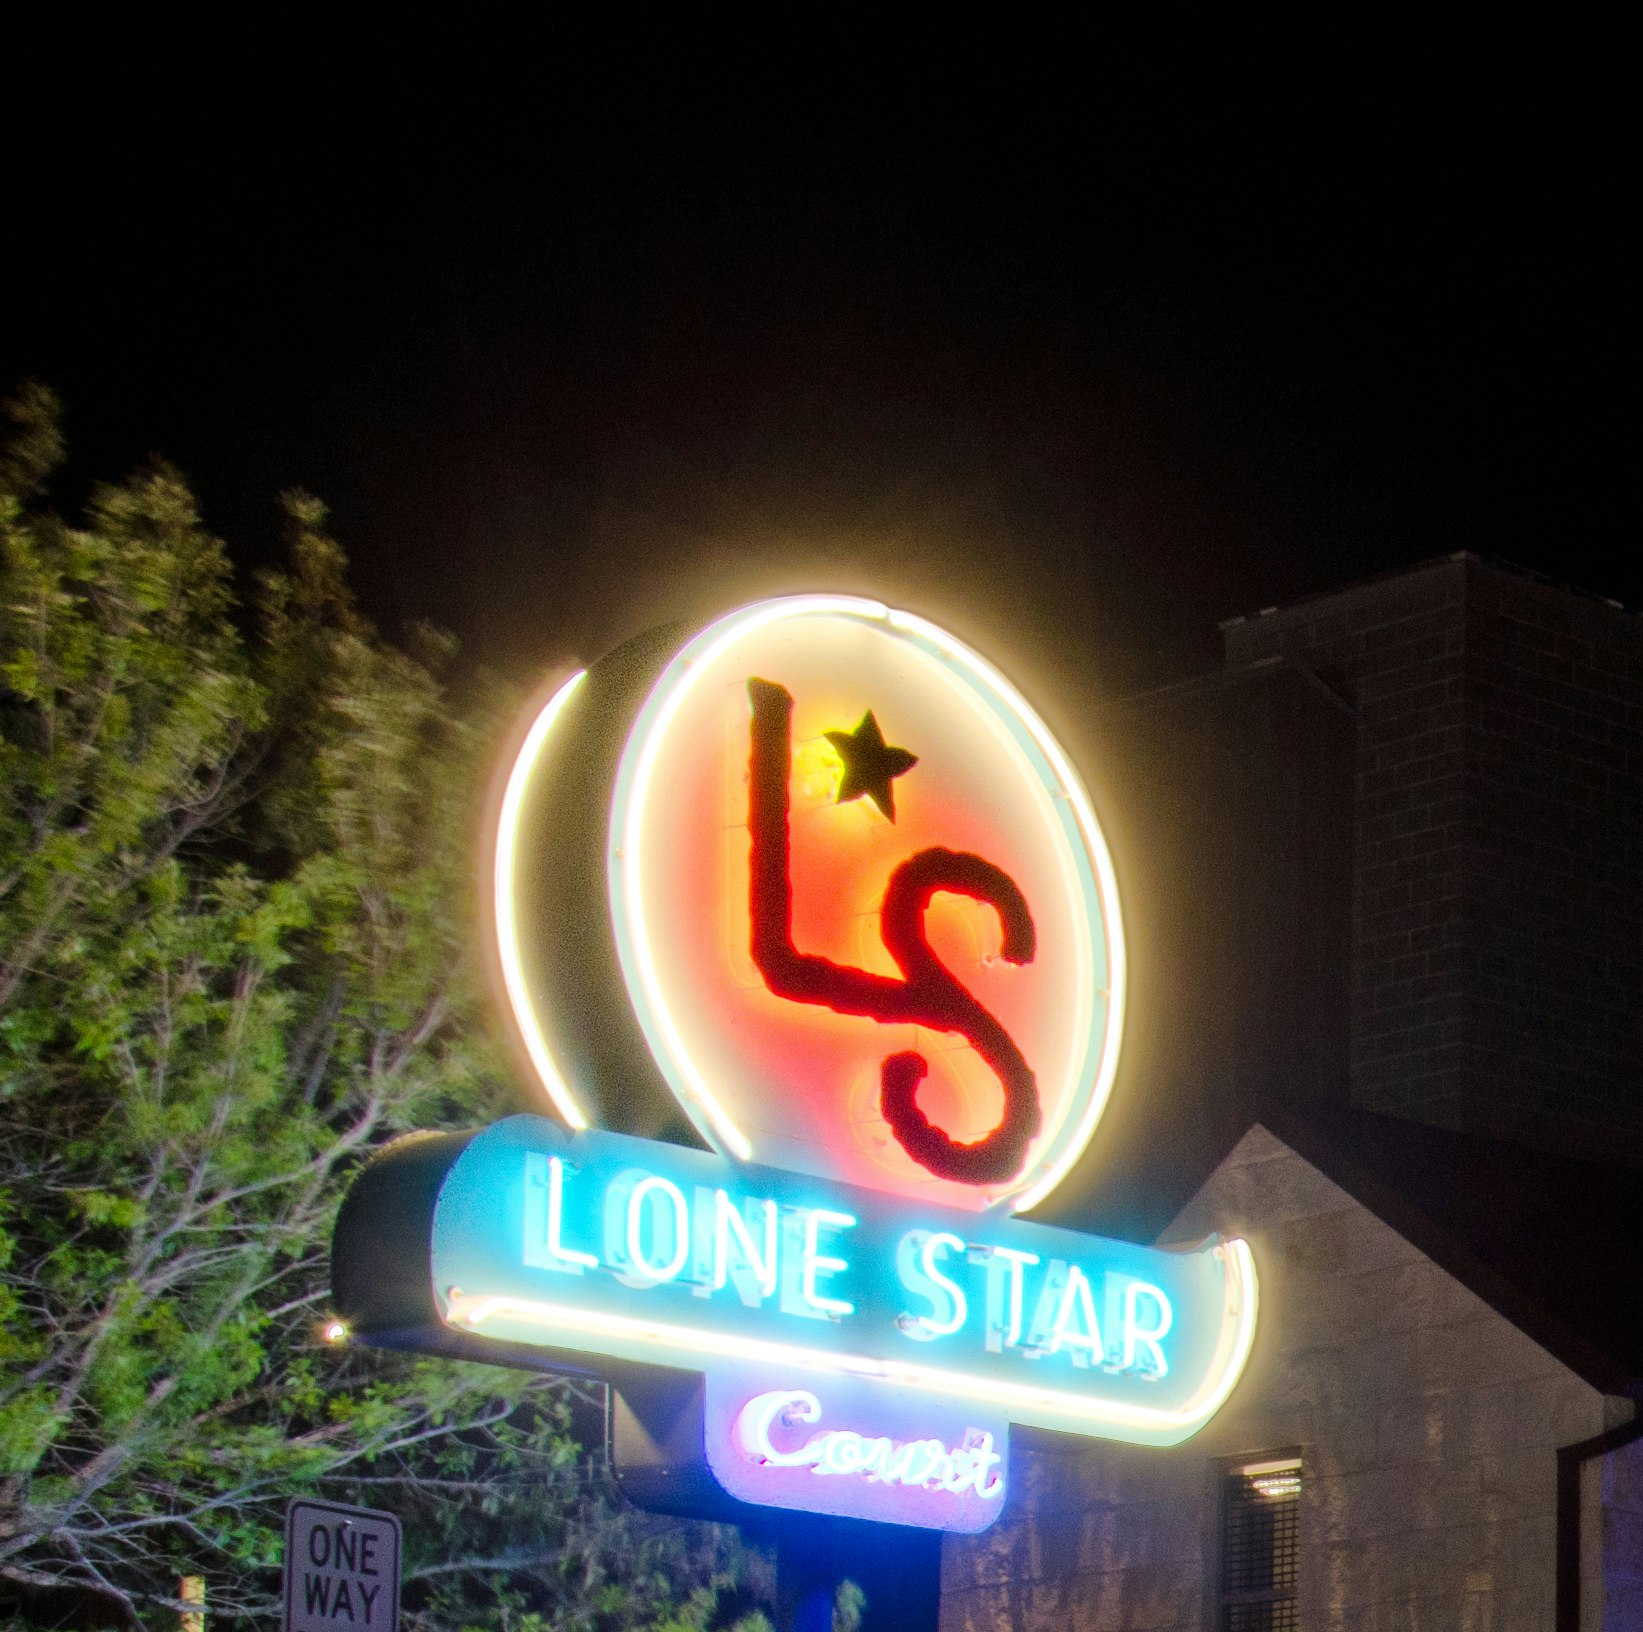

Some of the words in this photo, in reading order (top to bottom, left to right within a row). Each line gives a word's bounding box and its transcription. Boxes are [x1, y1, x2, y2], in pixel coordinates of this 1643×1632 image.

[524, 1151, 857, 1323] LONE
[896, 1229, 1172, 1381] STAR
[738, 1389, 1003, 1499] Court
[309, 1525, 378, 1576] ONE
[305, 1573, 381, 1624] WAY
